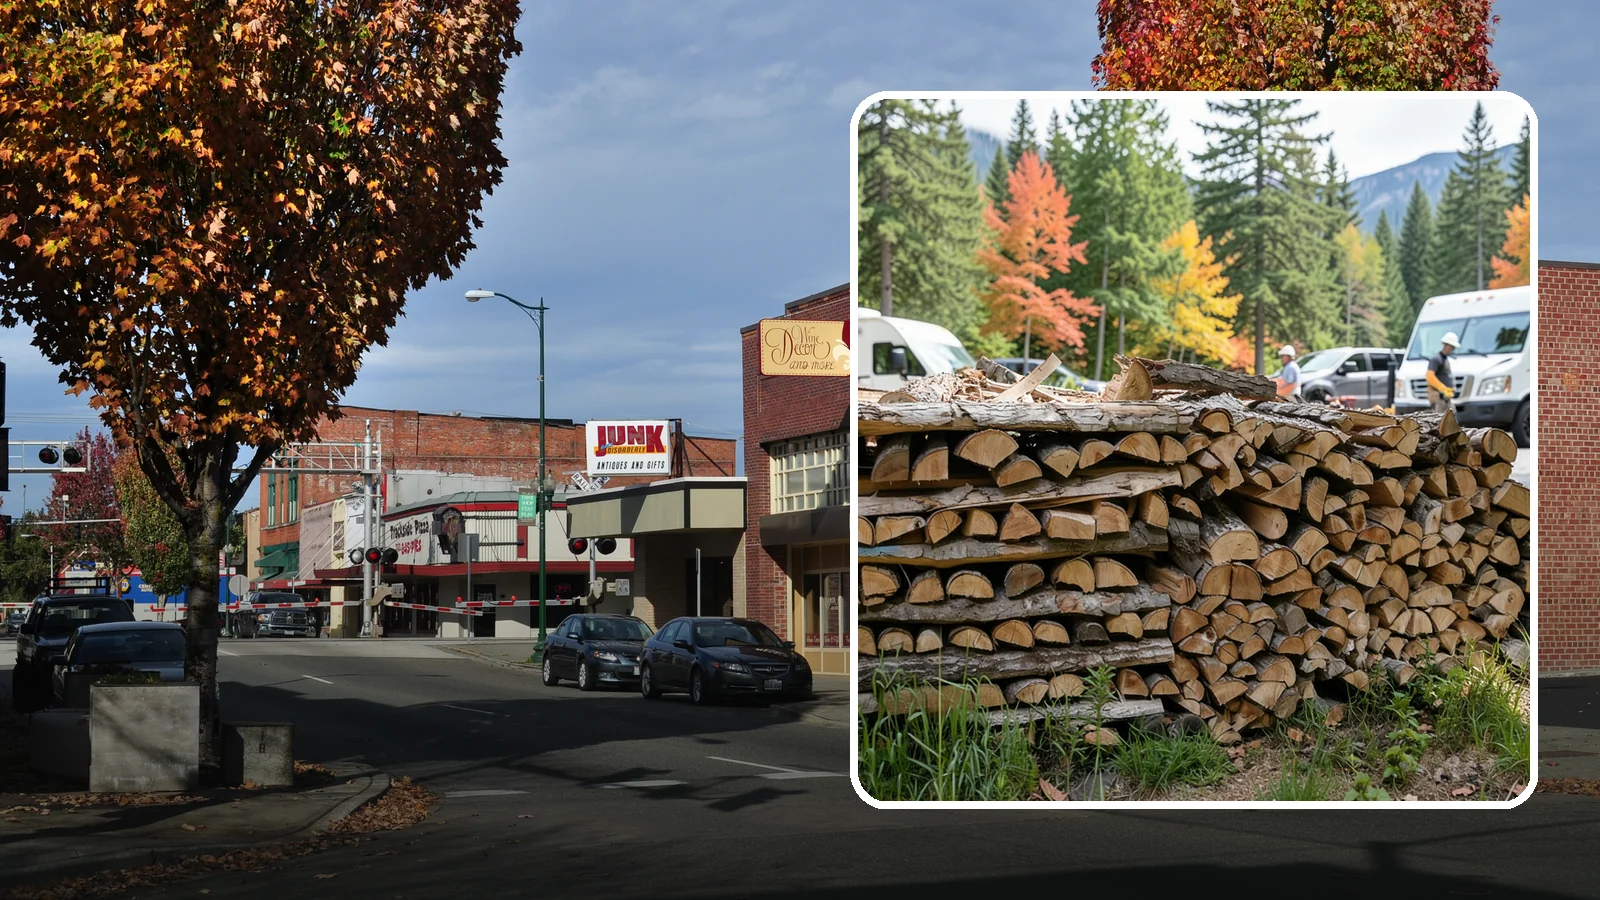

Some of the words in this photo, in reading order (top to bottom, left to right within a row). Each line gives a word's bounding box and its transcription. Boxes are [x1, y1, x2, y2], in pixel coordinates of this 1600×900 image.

[596, 425, 665, 457] JUNK
[607, 446, 646, 454] DISORDERLY
[596, 461, 628, 470] ANTIQUES
[631, 461, 644, 470] AND
[647, 460, 665, 470] GIFTS
